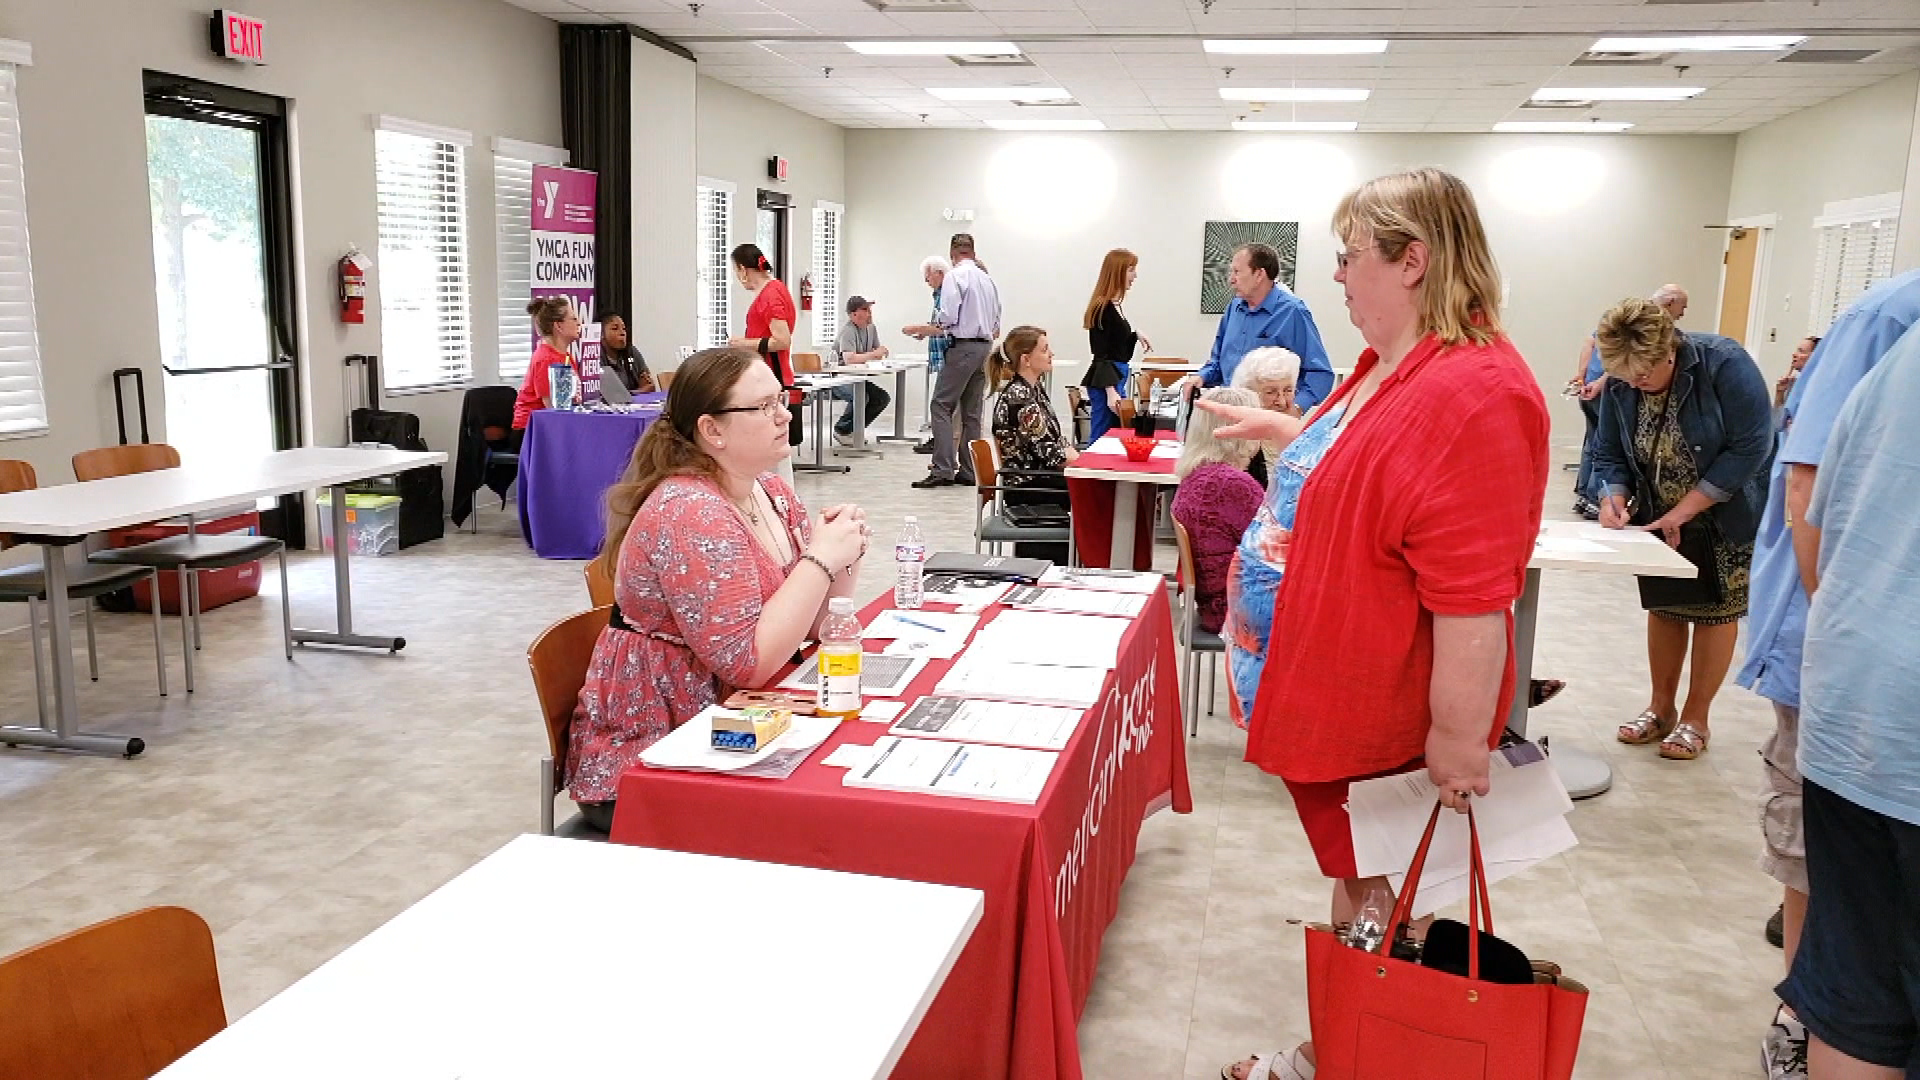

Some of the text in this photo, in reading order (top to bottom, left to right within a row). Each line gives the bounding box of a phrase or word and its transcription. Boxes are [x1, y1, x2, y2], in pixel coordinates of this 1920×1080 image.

[228, 16, 263, 59] EXIT
[536, 238, 595, 260] YMCA FUN
[536, 262, 595, 283] COMPANY
[583, 344, 600, 359] APPLY
